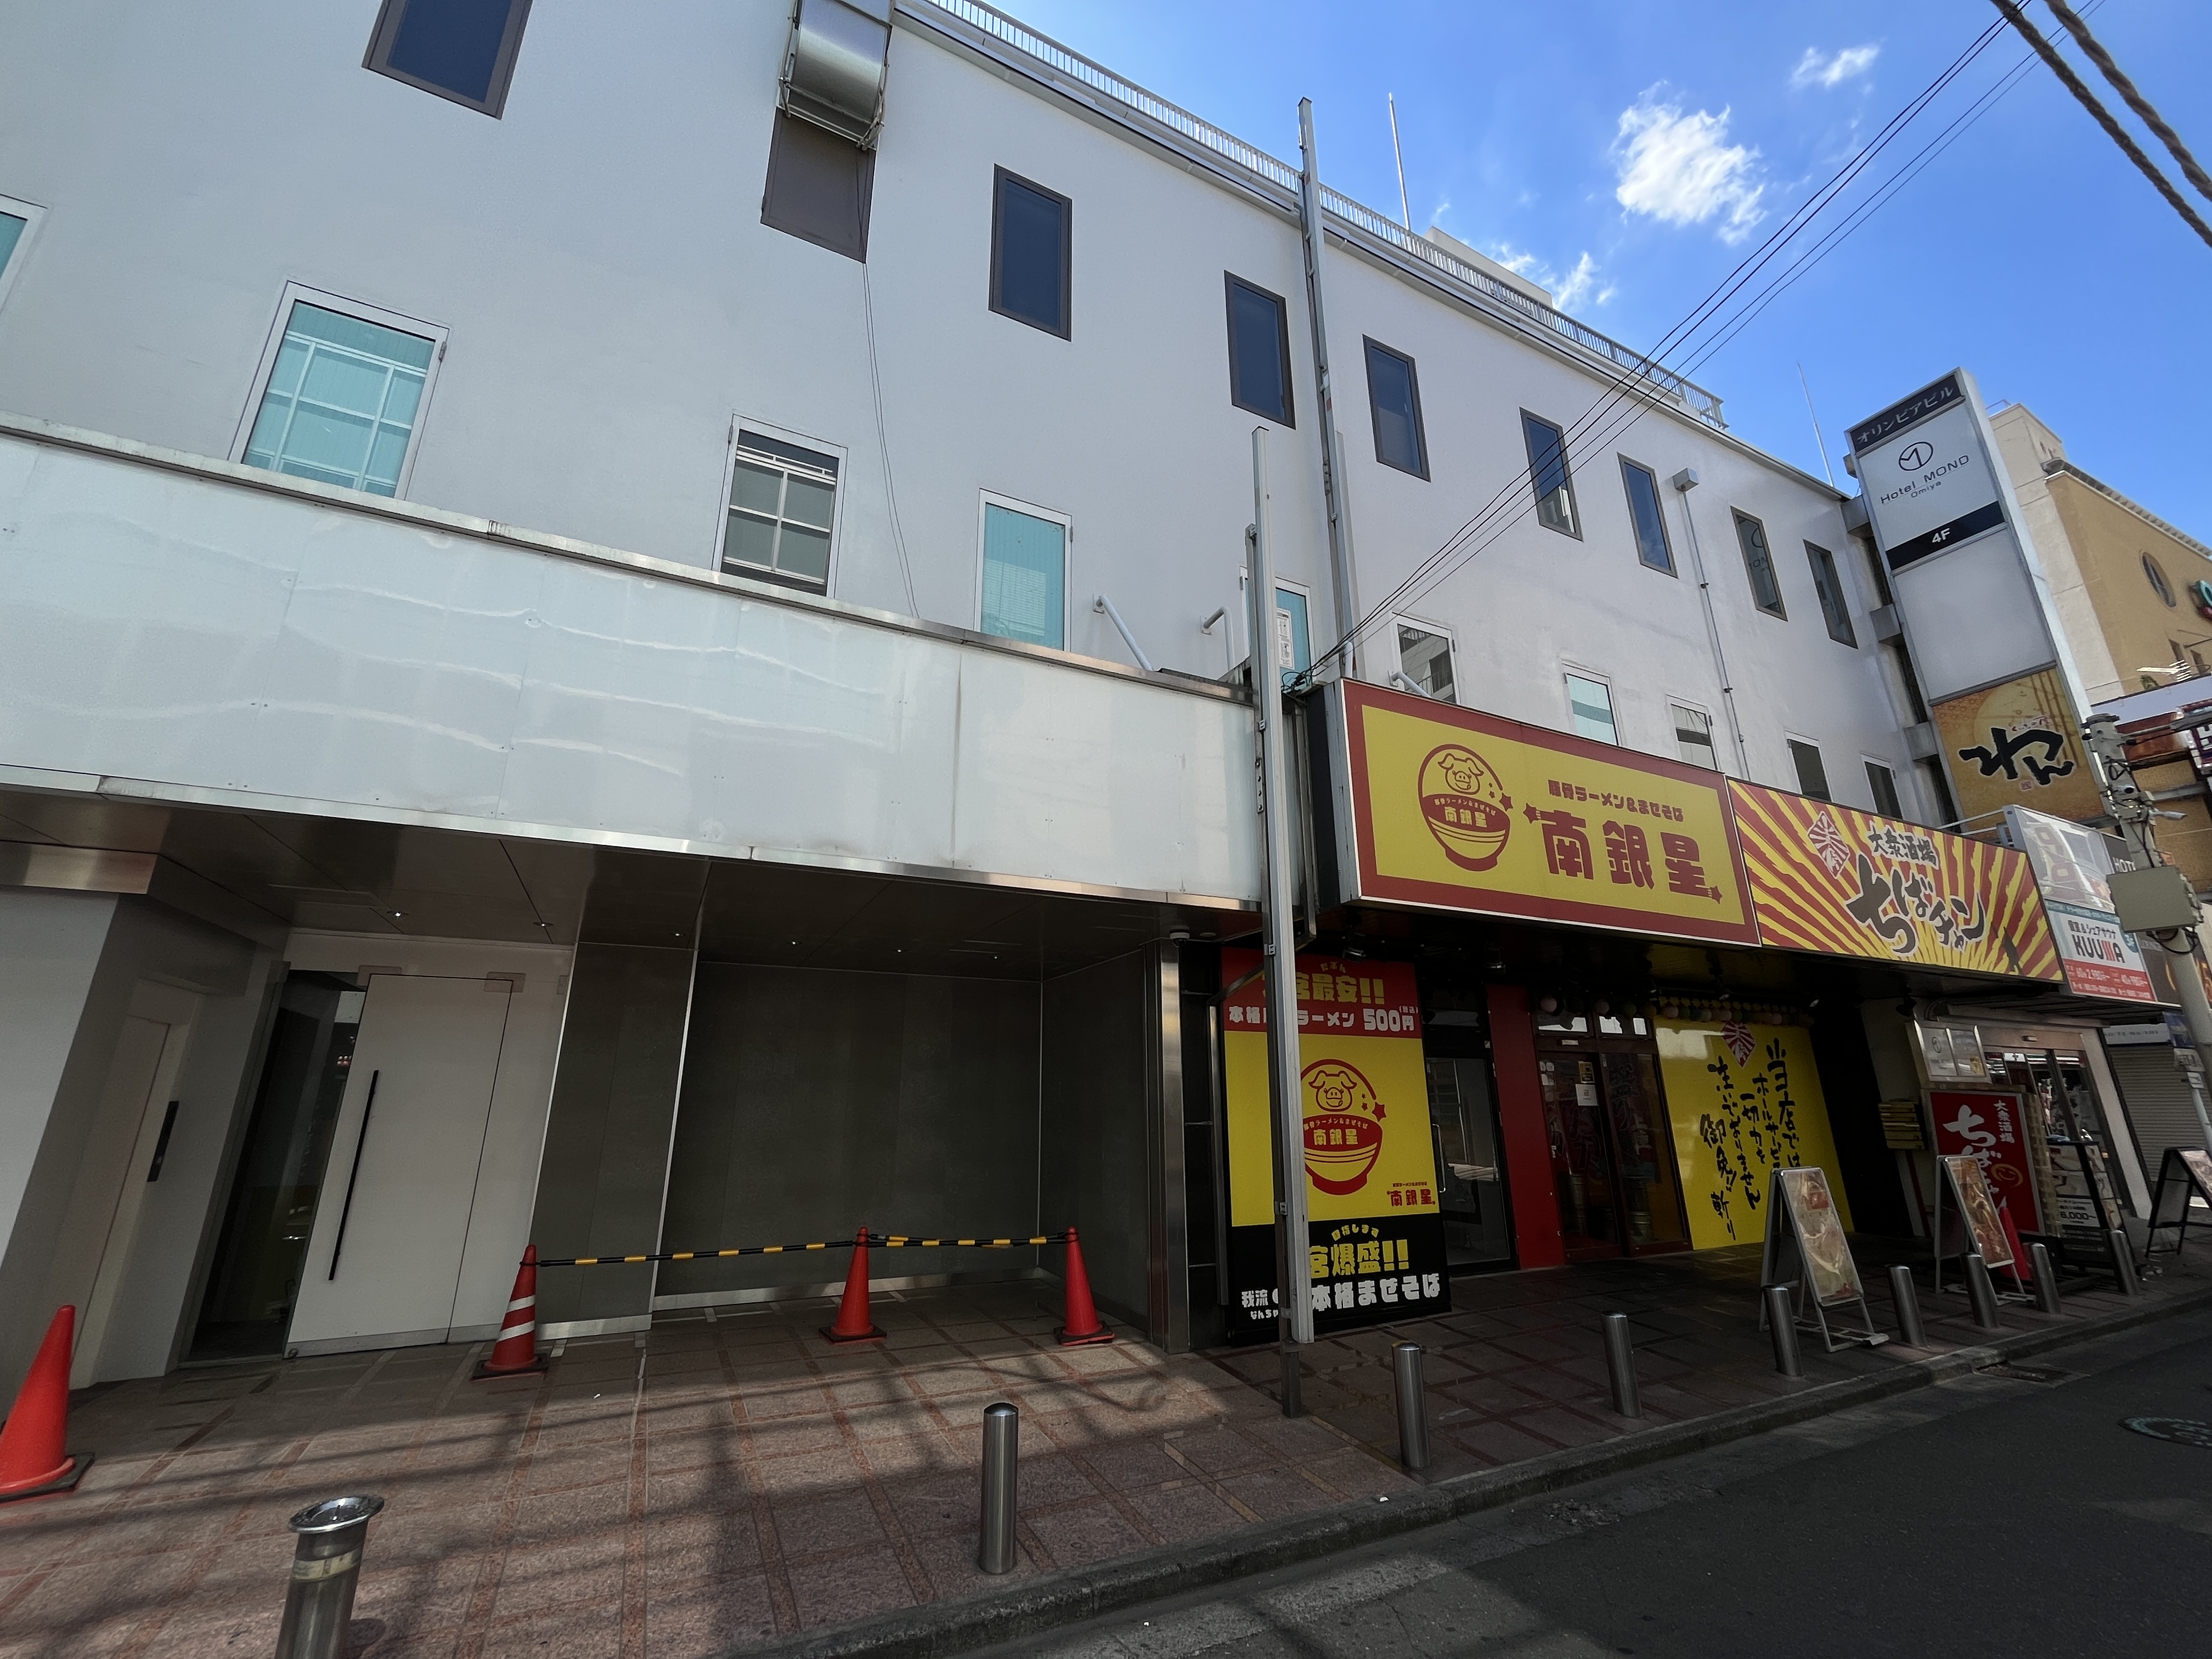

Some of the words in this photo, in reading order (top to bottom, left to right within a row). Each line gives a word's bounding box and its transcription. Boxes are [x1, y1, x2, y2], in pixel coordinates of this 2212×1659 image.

[1858, 386, 1954, 443] オリンピアビル
[1880, 481, 1916, 504] Hotel
[1911, 481, 1942, 498] Omiya
[1932, 528, 1950, 543] 4F
[1958, 727, 2074, 786] わん
[1538, 810, 1713, 898] 南銀星
[1866, 823, 1938, 868] 大衆酒場
[1993, 1099, 2016, 1144] 大衆酒場
